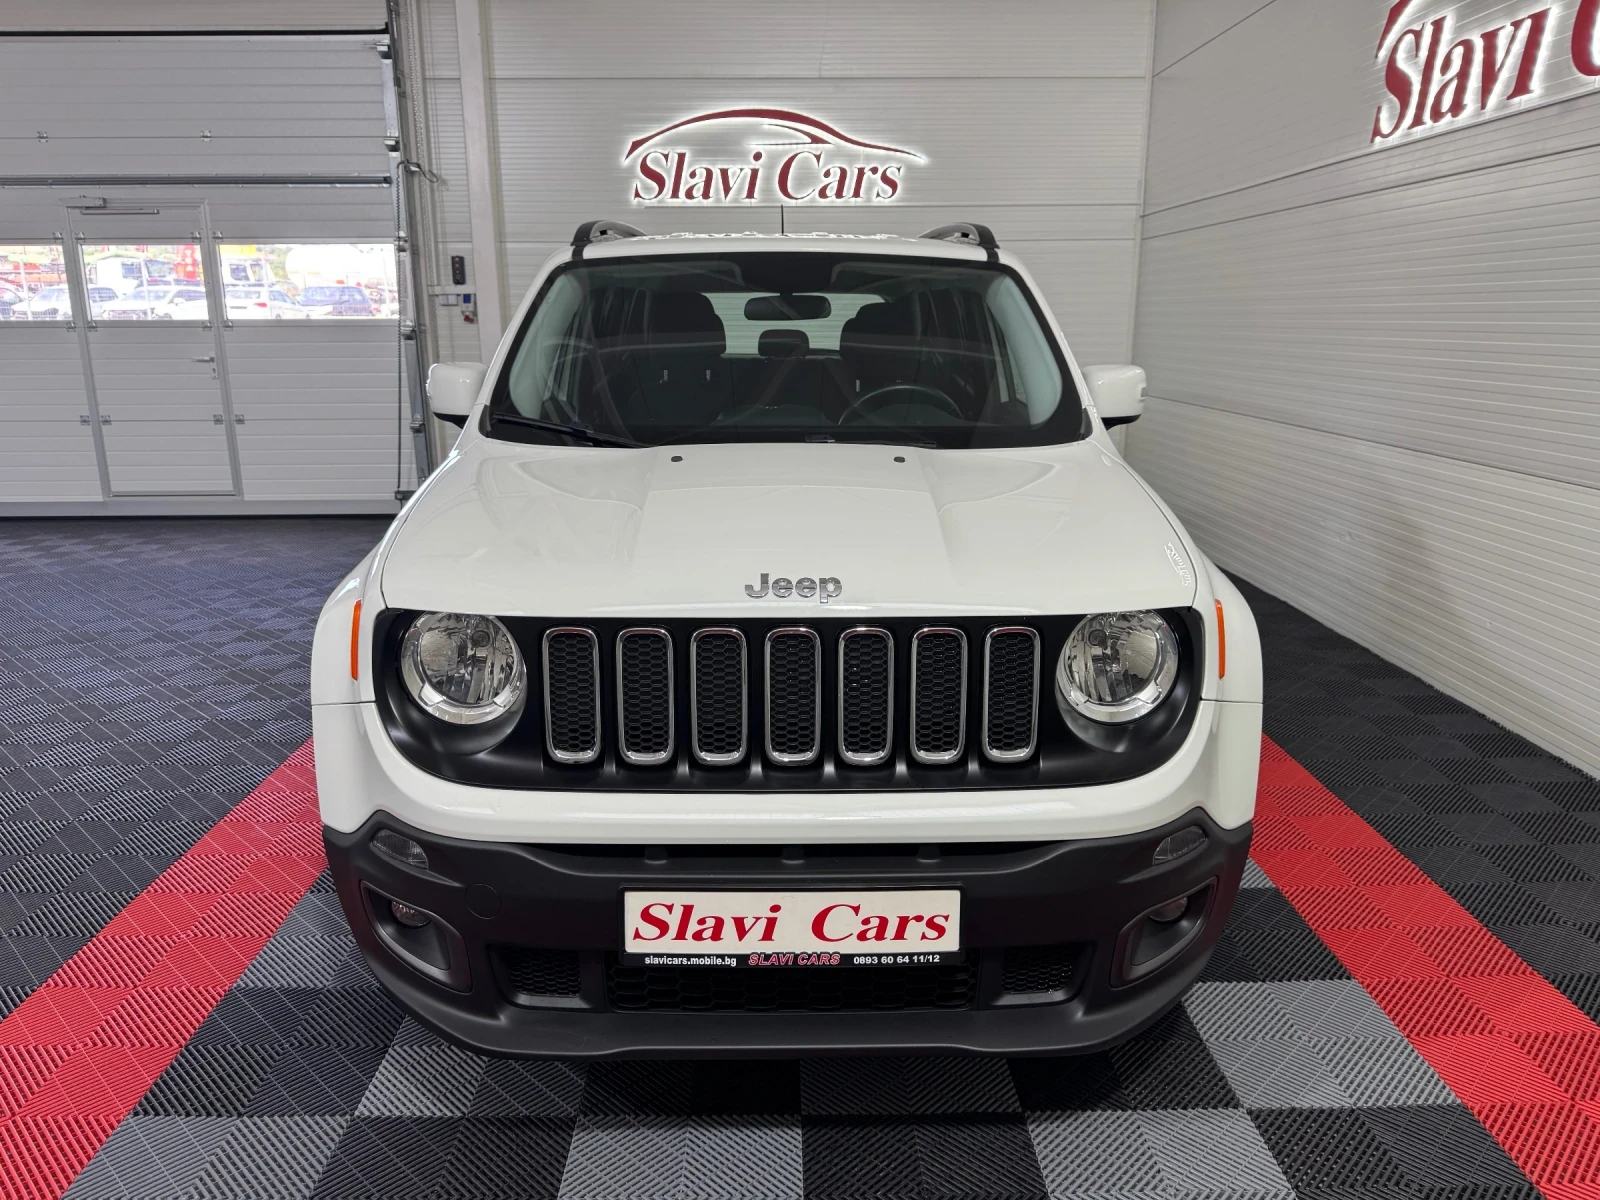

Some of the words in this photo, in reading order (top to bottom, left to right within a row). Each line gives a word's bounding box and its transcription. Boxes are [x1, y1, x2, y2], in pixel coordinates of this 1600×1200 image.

[1370, 7, 1552, 143] Slavi
[633, 151, 763, 200] Slavi
[777, 151, 903, 200] Cars
[744, 573, 842, 603] Jeep
[632, 902, 782, 942] Slavi
[810, 903, 950, 942] Cars
[644, 955, 737, 967] slavicars.mobile.bg
[748, 953, 795, 966] SLAVI
[797, 953, 841, 965] CARS
[853, 956, 878, 964] 0893
[881, 956, 894, 964] 60
[896, 955, 909, 964] 64
[912, 954, 940, 963] 11/12
